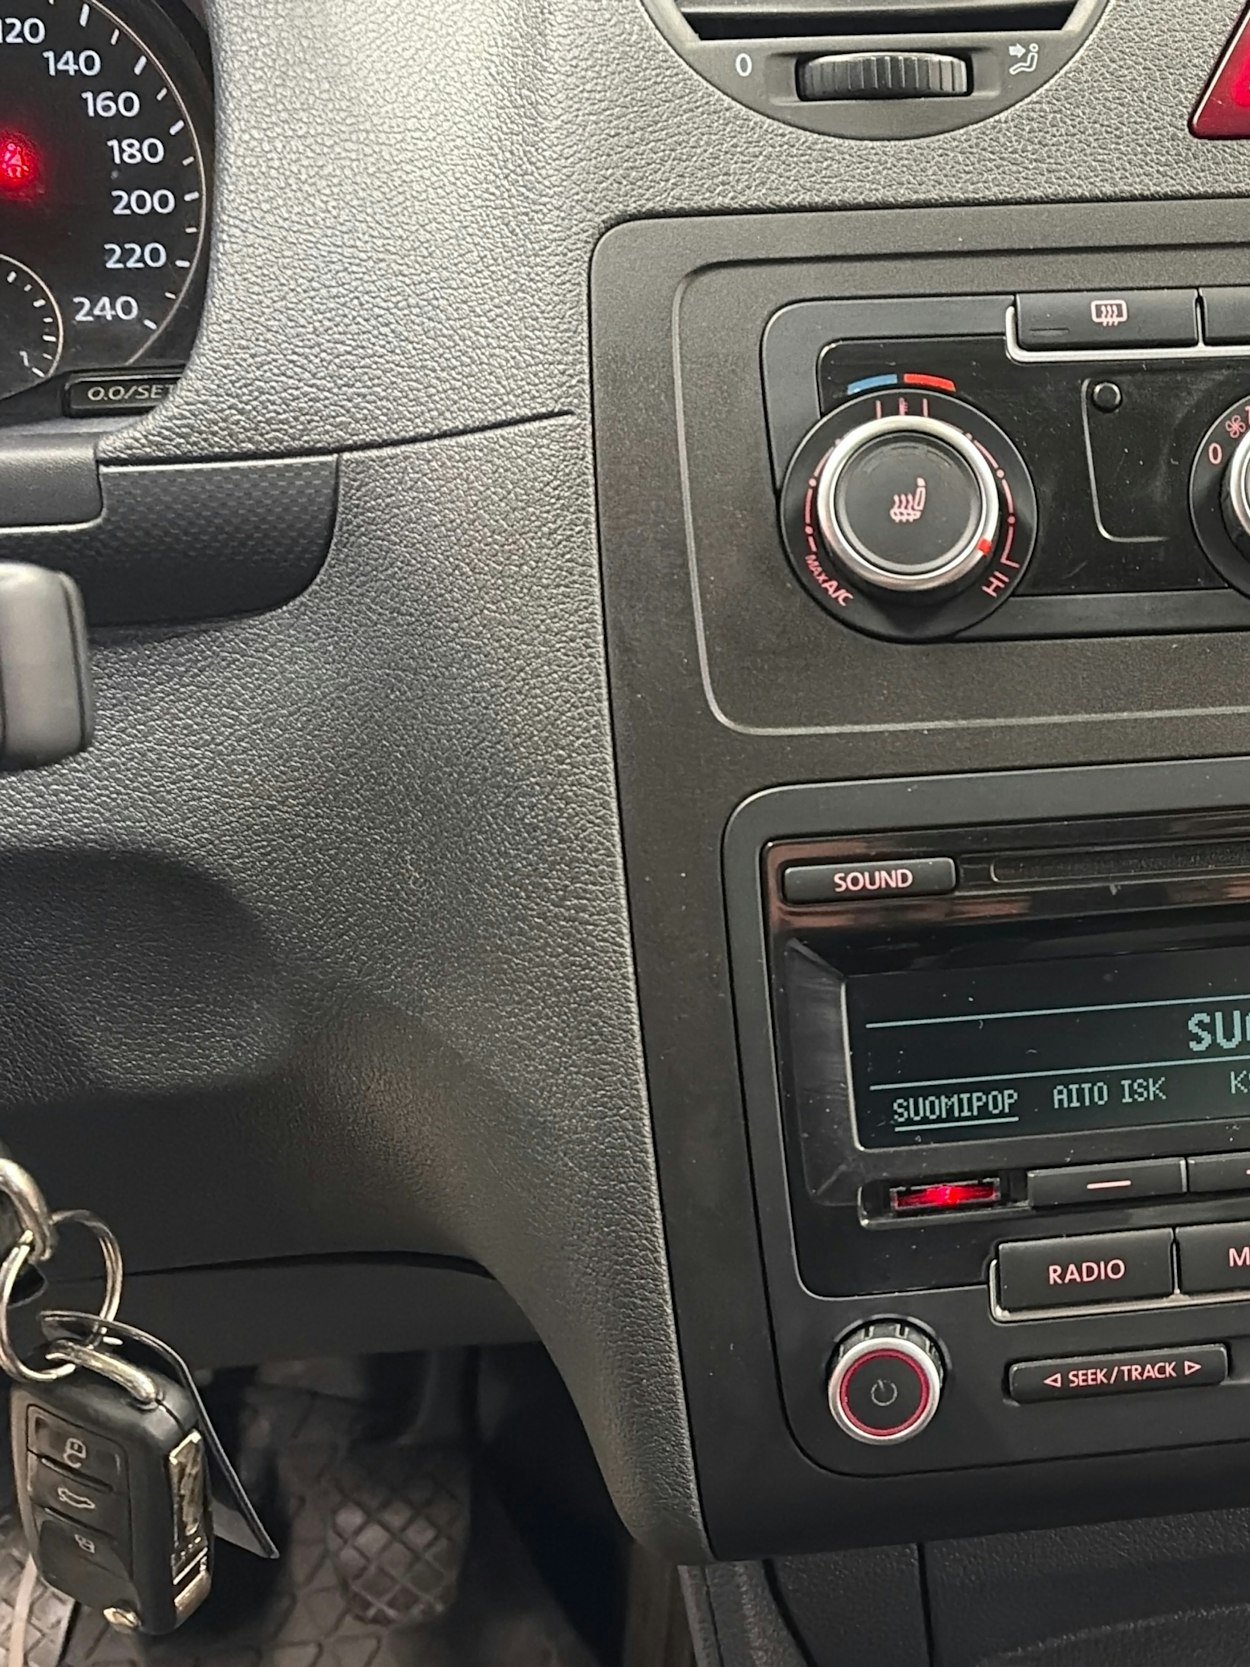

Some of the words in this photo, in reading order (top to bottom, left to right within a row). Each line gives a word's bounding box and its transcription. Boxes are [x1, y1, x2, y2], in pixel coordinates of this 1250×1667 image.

[42, 49, 102, 76] 140
[81, 91, 141, 117] 160
[107, 137, 165, 164] 180
[112, 189, 176, 215] 200
[104, 242, 167, 269] 220
[73, 296, 139, 322] 240
[1207, 442, 1223, 465] 0
[833, 868, 914, 893] SOUND
[892, 1088, 1018, 1124] SUOMIPOP
[1052, 1081, 1108, 1110] AITO
[1120, 1076, 1167, 1104] ISK
[1048, 1258, 1126, 1285] RADIO
